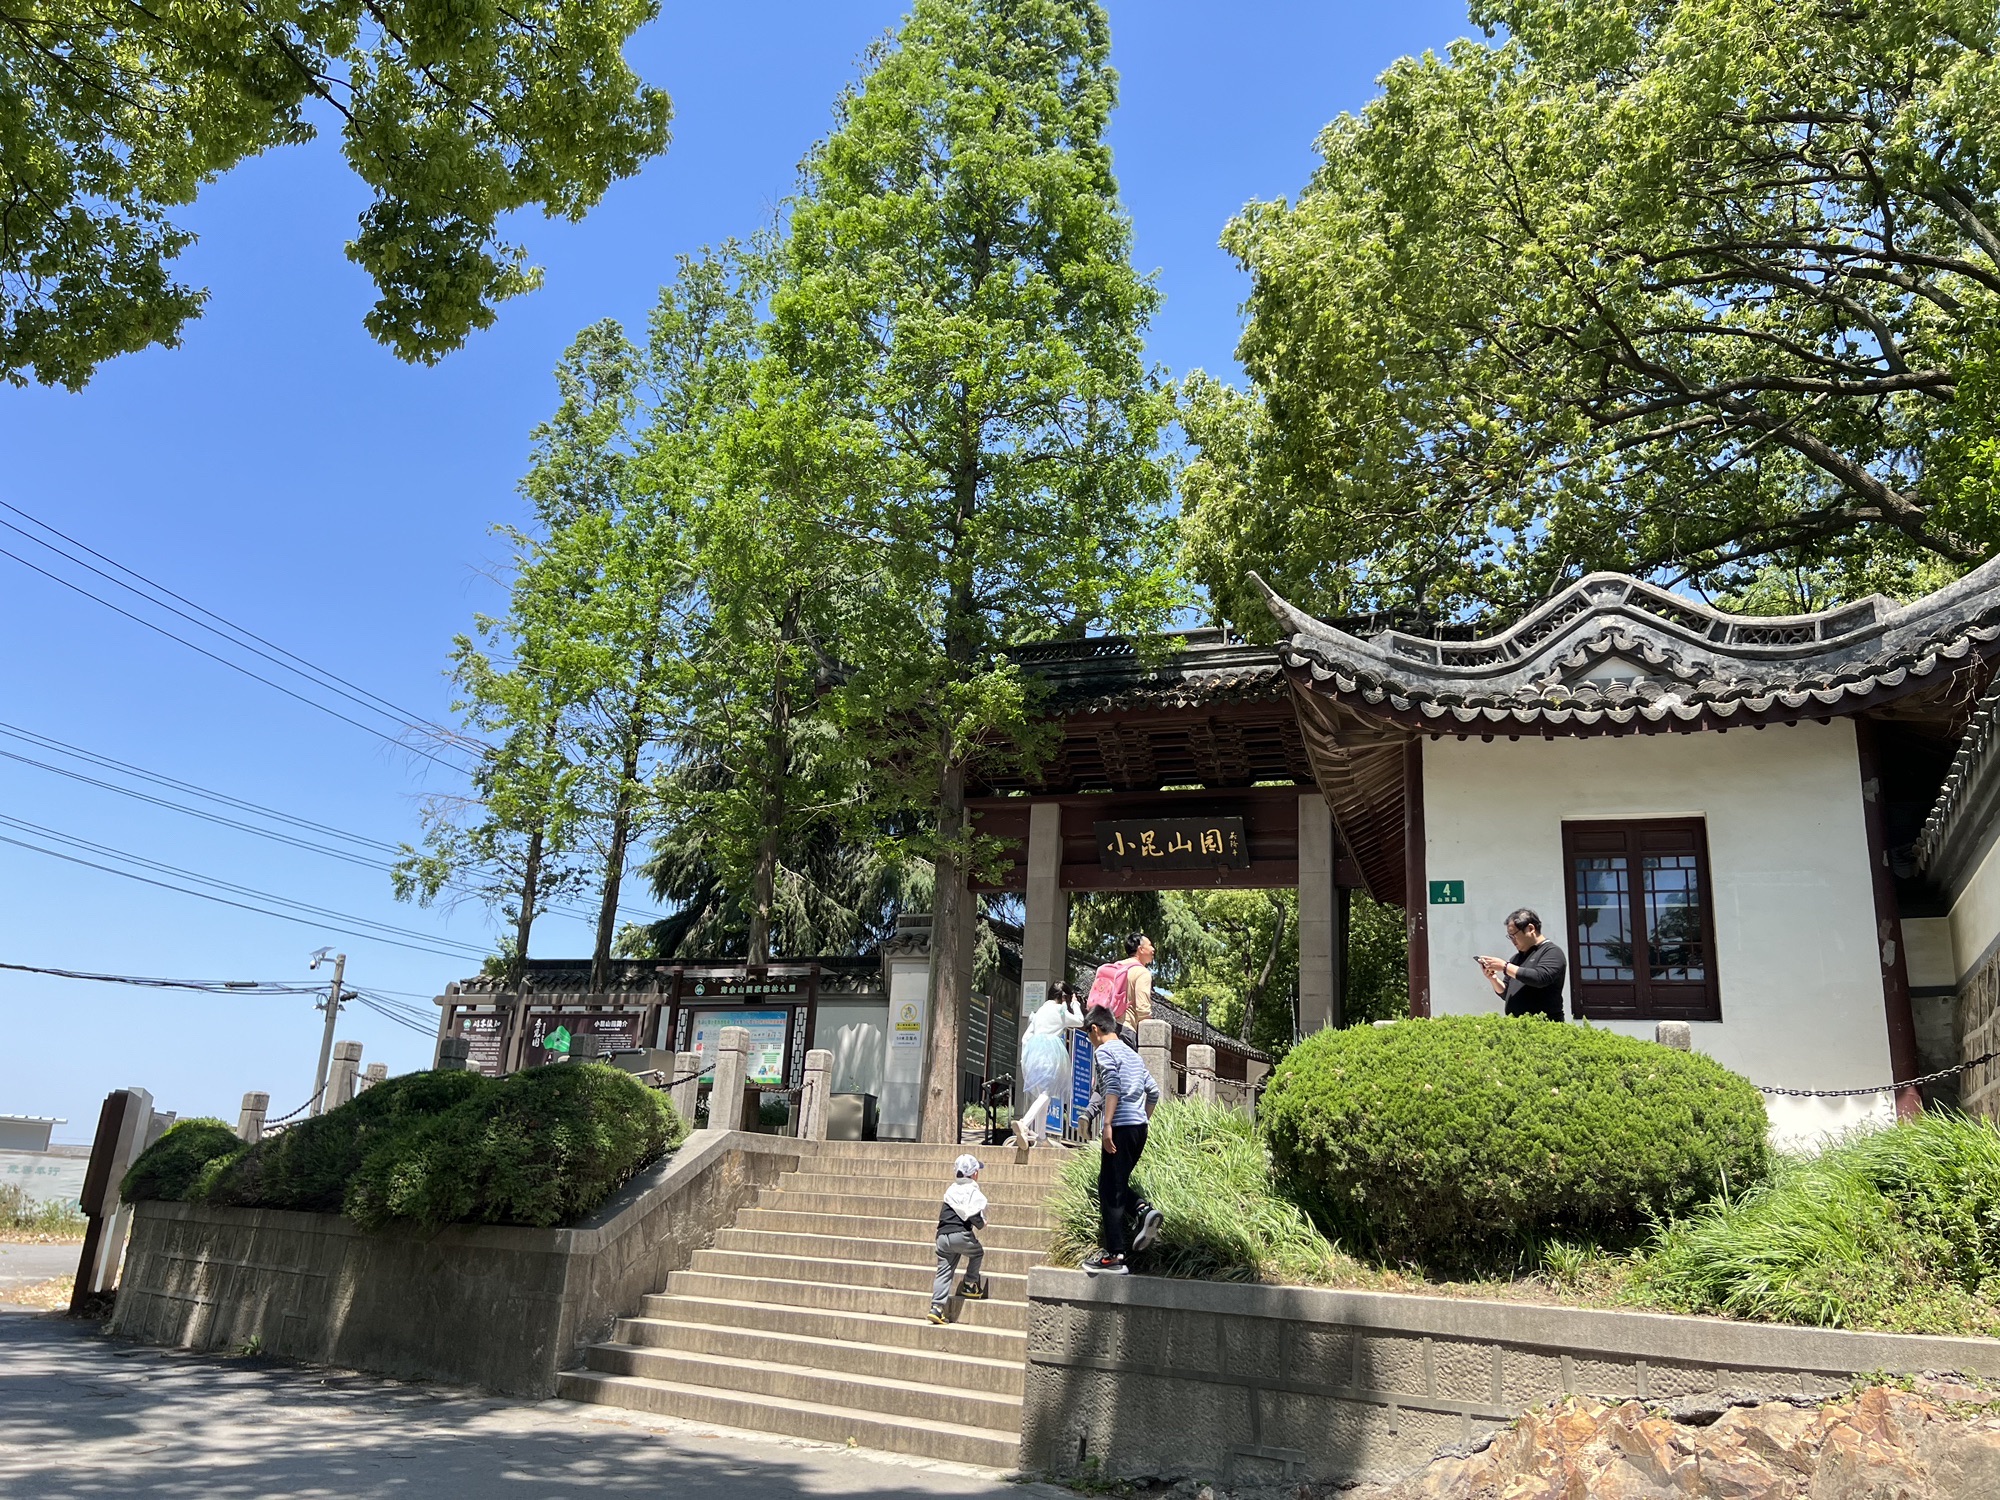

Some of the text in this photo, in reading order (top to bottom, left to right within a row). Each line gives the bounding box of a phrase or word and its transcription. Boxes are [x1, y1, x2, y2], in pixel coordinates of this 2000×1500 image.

[1107, 828, 1224, 857] 小昆山园
[1442, 883, 1451, 896] 4
